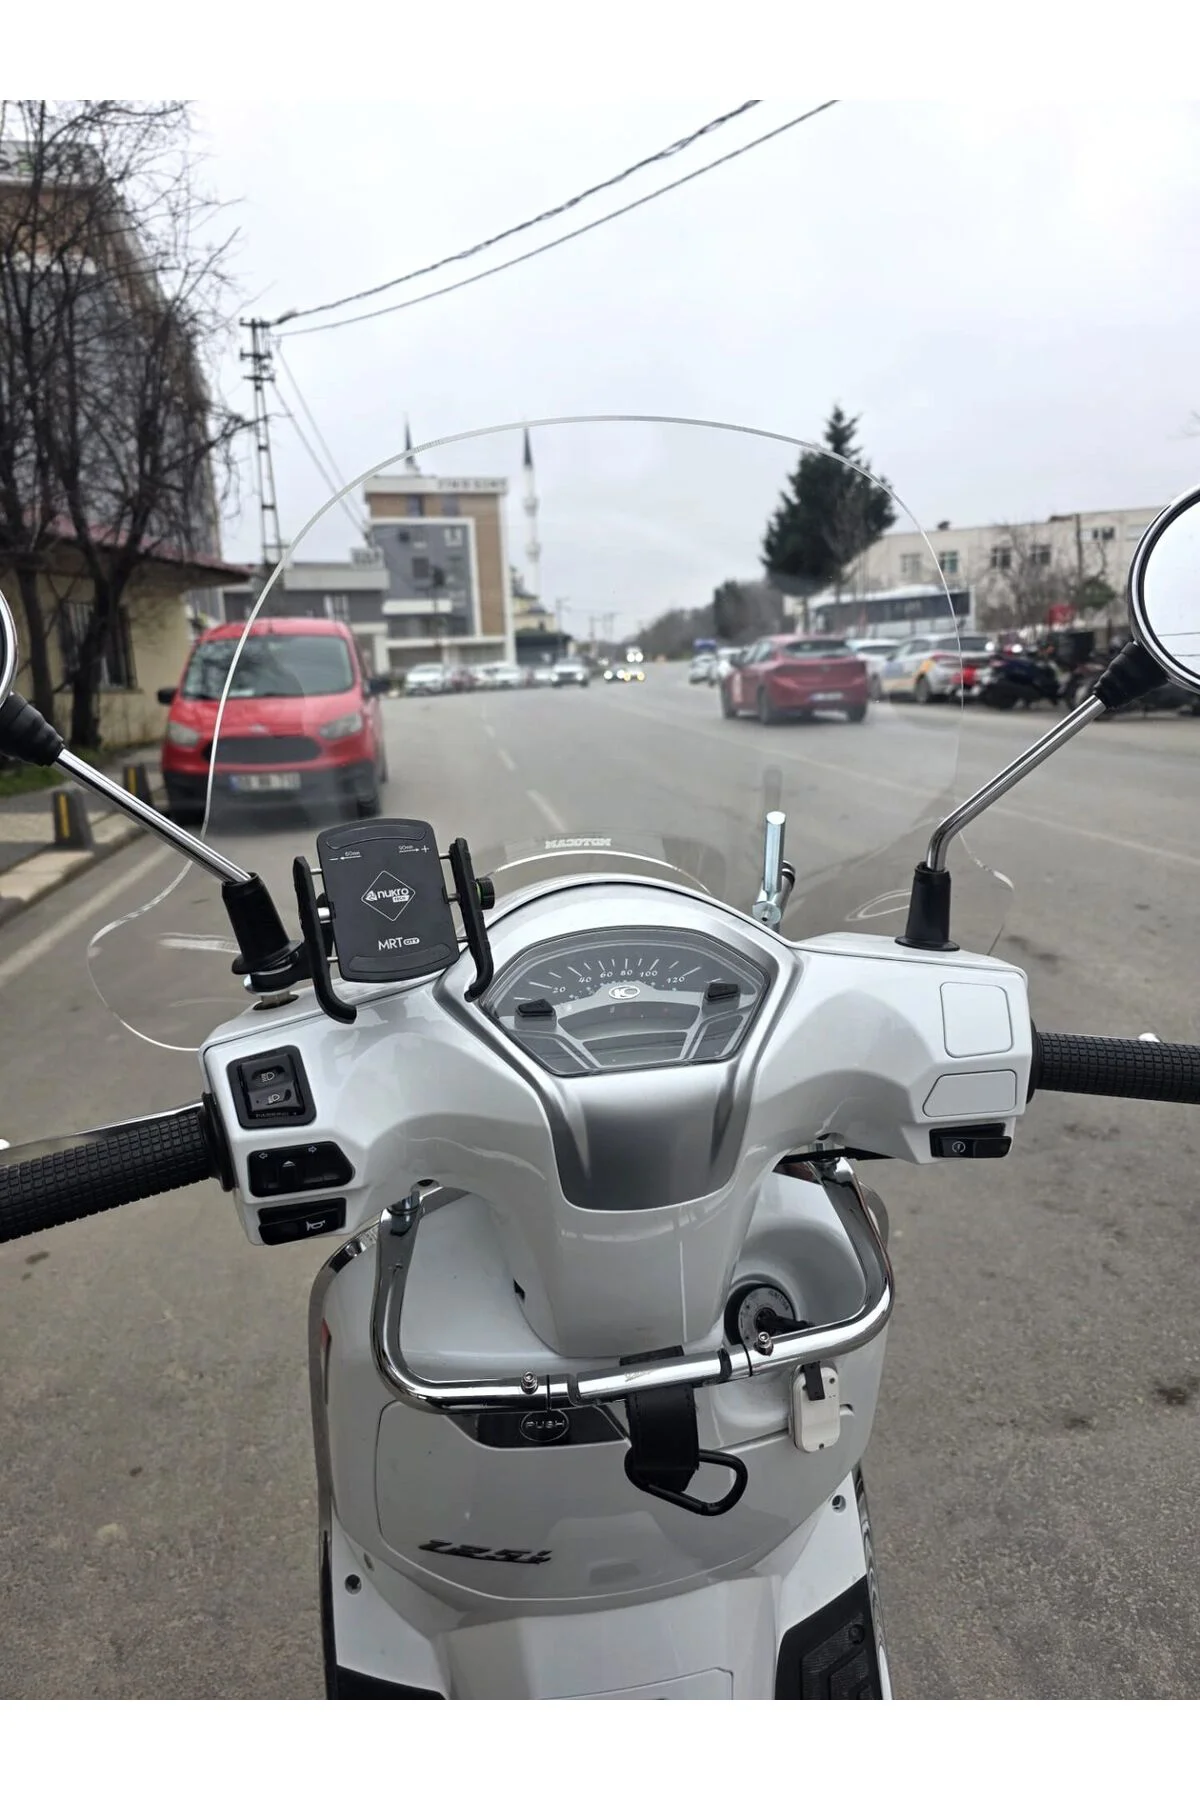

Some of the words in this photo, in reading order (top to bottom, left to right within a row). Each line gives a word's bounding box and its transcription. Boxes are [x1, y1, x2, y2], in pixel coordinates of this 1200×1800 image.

[378, 936, 403, 951] MRT
[600, 970, 614, 978] 60
[639, 970, 658, 978] 100
[579, 976, 593, 984] 40
[666, 975, 686, 984] 120
[552, 986, 566, 994] 20
[525, 1418, 566, 1429] PUSH
